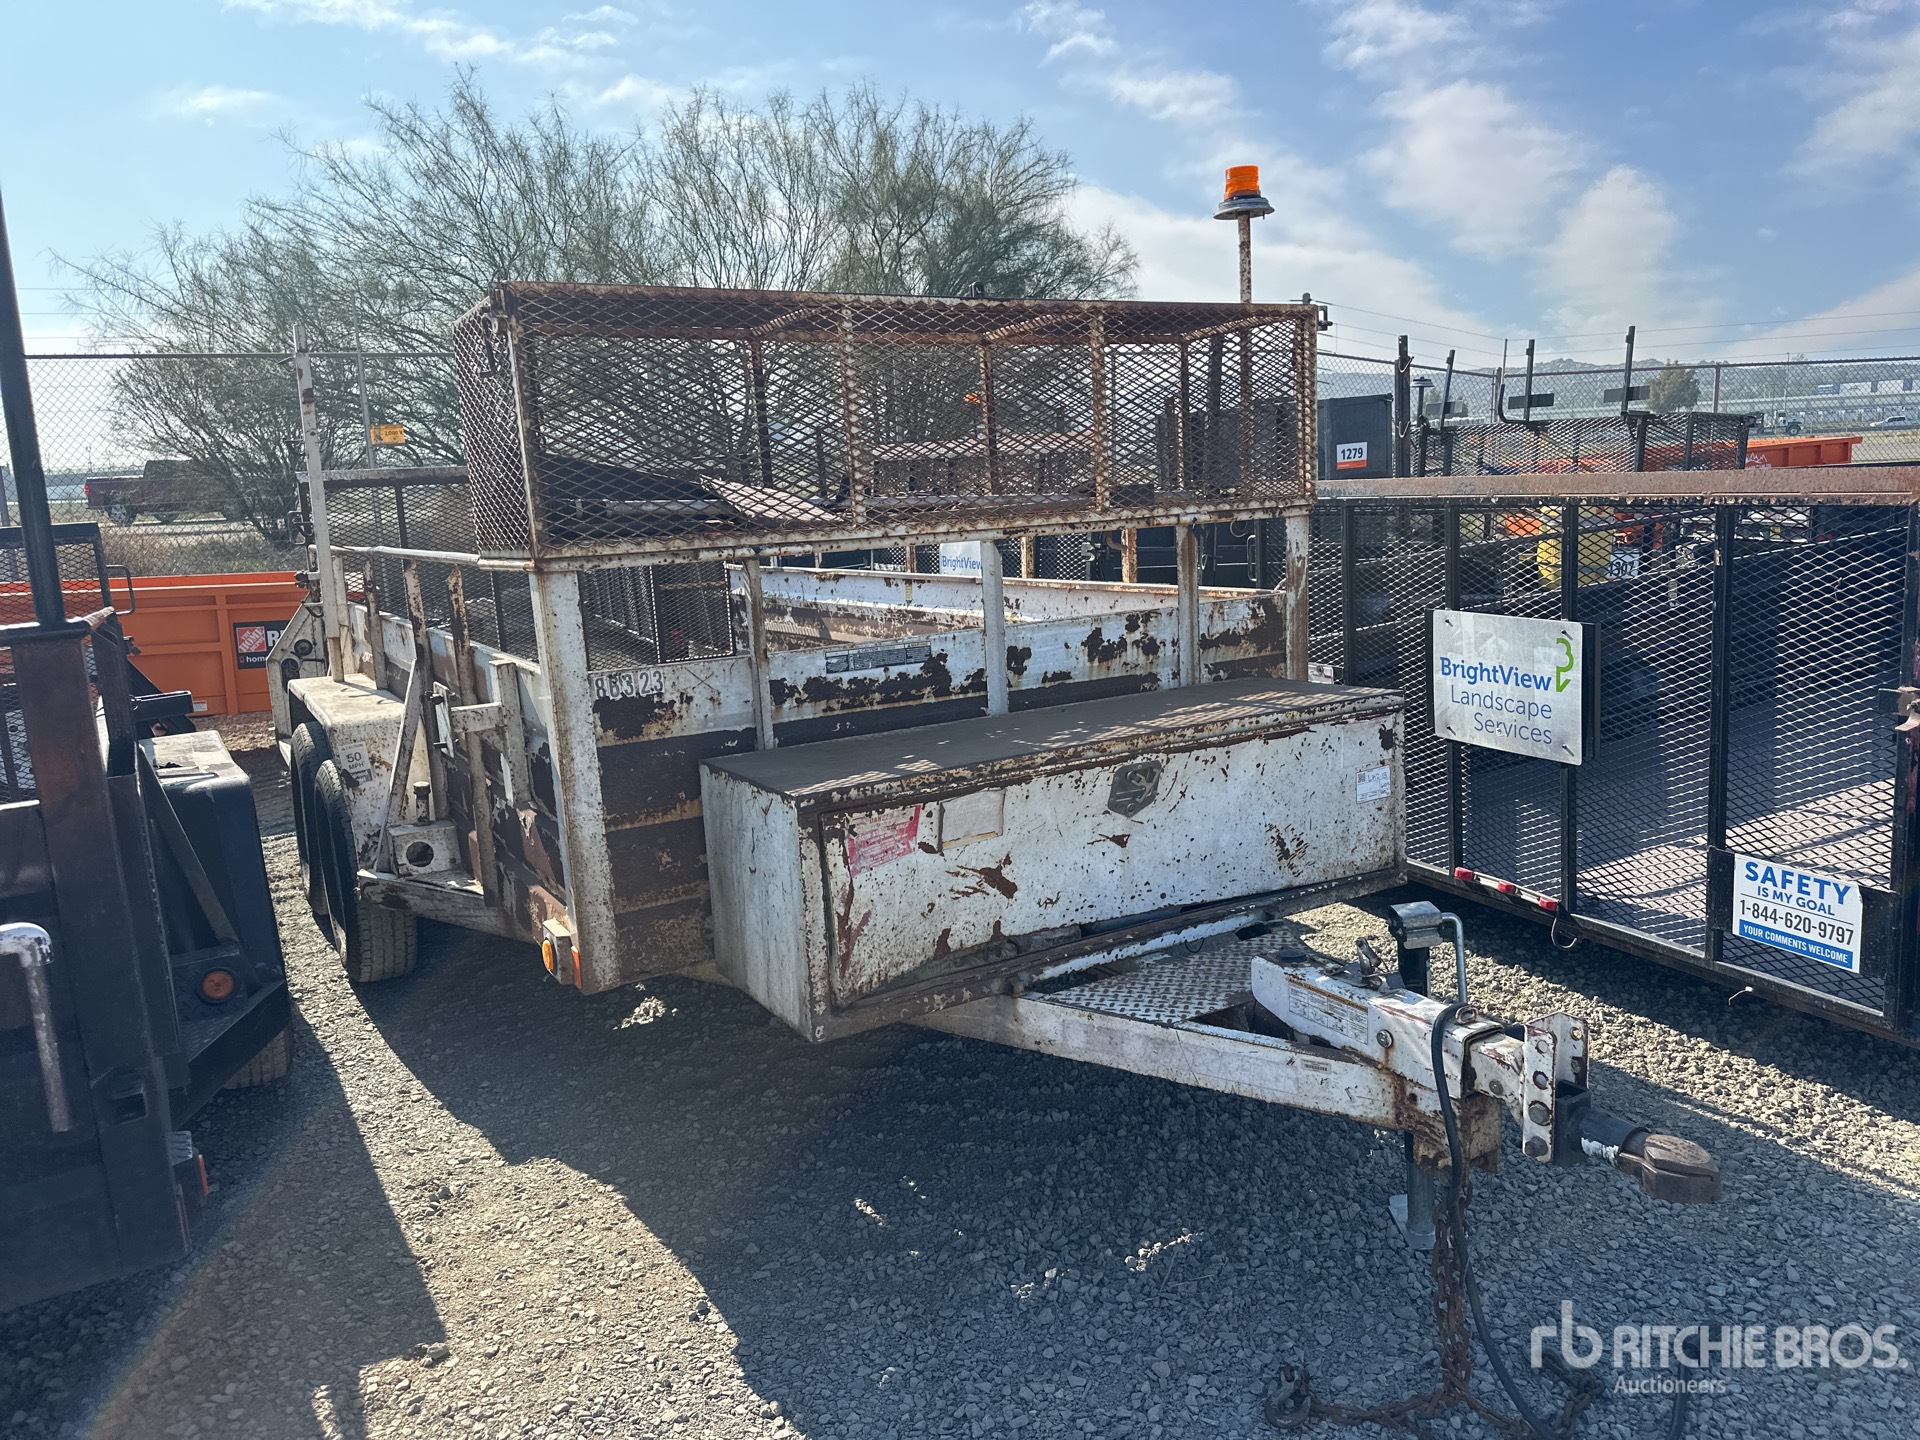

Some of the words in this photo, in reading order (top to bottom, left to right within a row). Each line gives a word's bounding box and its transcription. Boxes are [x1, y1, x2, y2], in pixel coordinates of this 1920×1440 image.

[1341, 447, 1363, 460] 1279
[239, 627, 265, 653] HOME
[1440, 656, 1552, 691] BrightView
[1451, 684, 1552, 721] Landscape
[1473, 712, 1552, 745] Services
[345, 751, 362, 763] 50
[348, 761, 365, 770] MPH
[1745, 861, 1851, 905] SAFETY
[1757, 886, 1769, 898] IS
[1772, 890, 1793, 903] MY
[1796, 897, 1835, 916] GOAL
[1740, 899, 1854, 946] 1-844-620-9797
[1743, 924, 1763, 938] YOUR
[1765, 930, 1807, 951] COMMENTS
[1808, 943, 1848, 964] WELCOME
